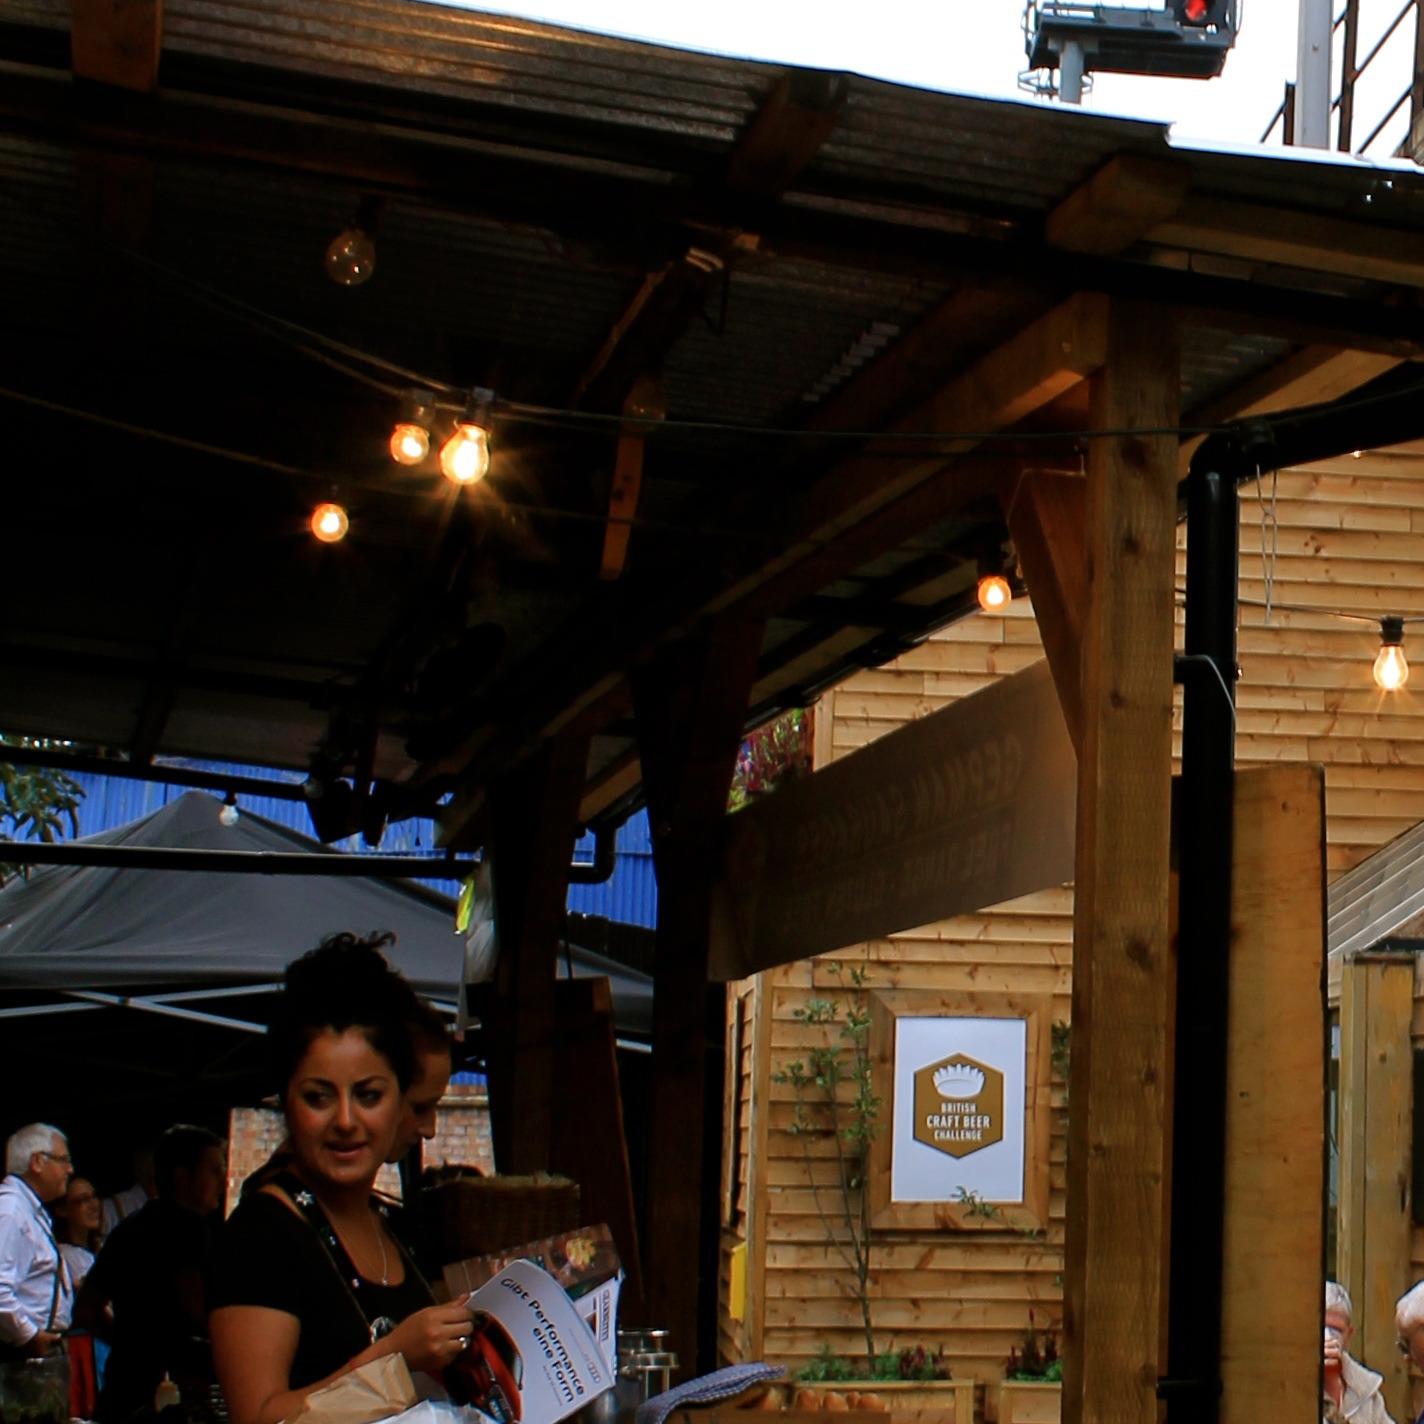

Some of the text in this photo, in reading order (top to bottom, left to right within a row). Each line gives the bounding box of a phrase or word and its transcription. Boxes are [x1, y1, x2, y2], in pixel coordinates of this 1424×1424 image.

[941, 1102, 976, 1113] BRITISH
[926, 1115, 990, 1128] CRAFT BEER
[934, 1129, 982, 1141] CHALLENGE
[501, 1278, 530, 1300] Gibt
[529, 1299, 585, 1395] Performance
[533, 1327, 554, 1359] eine
[552, 1361, 574, 1403] Form
